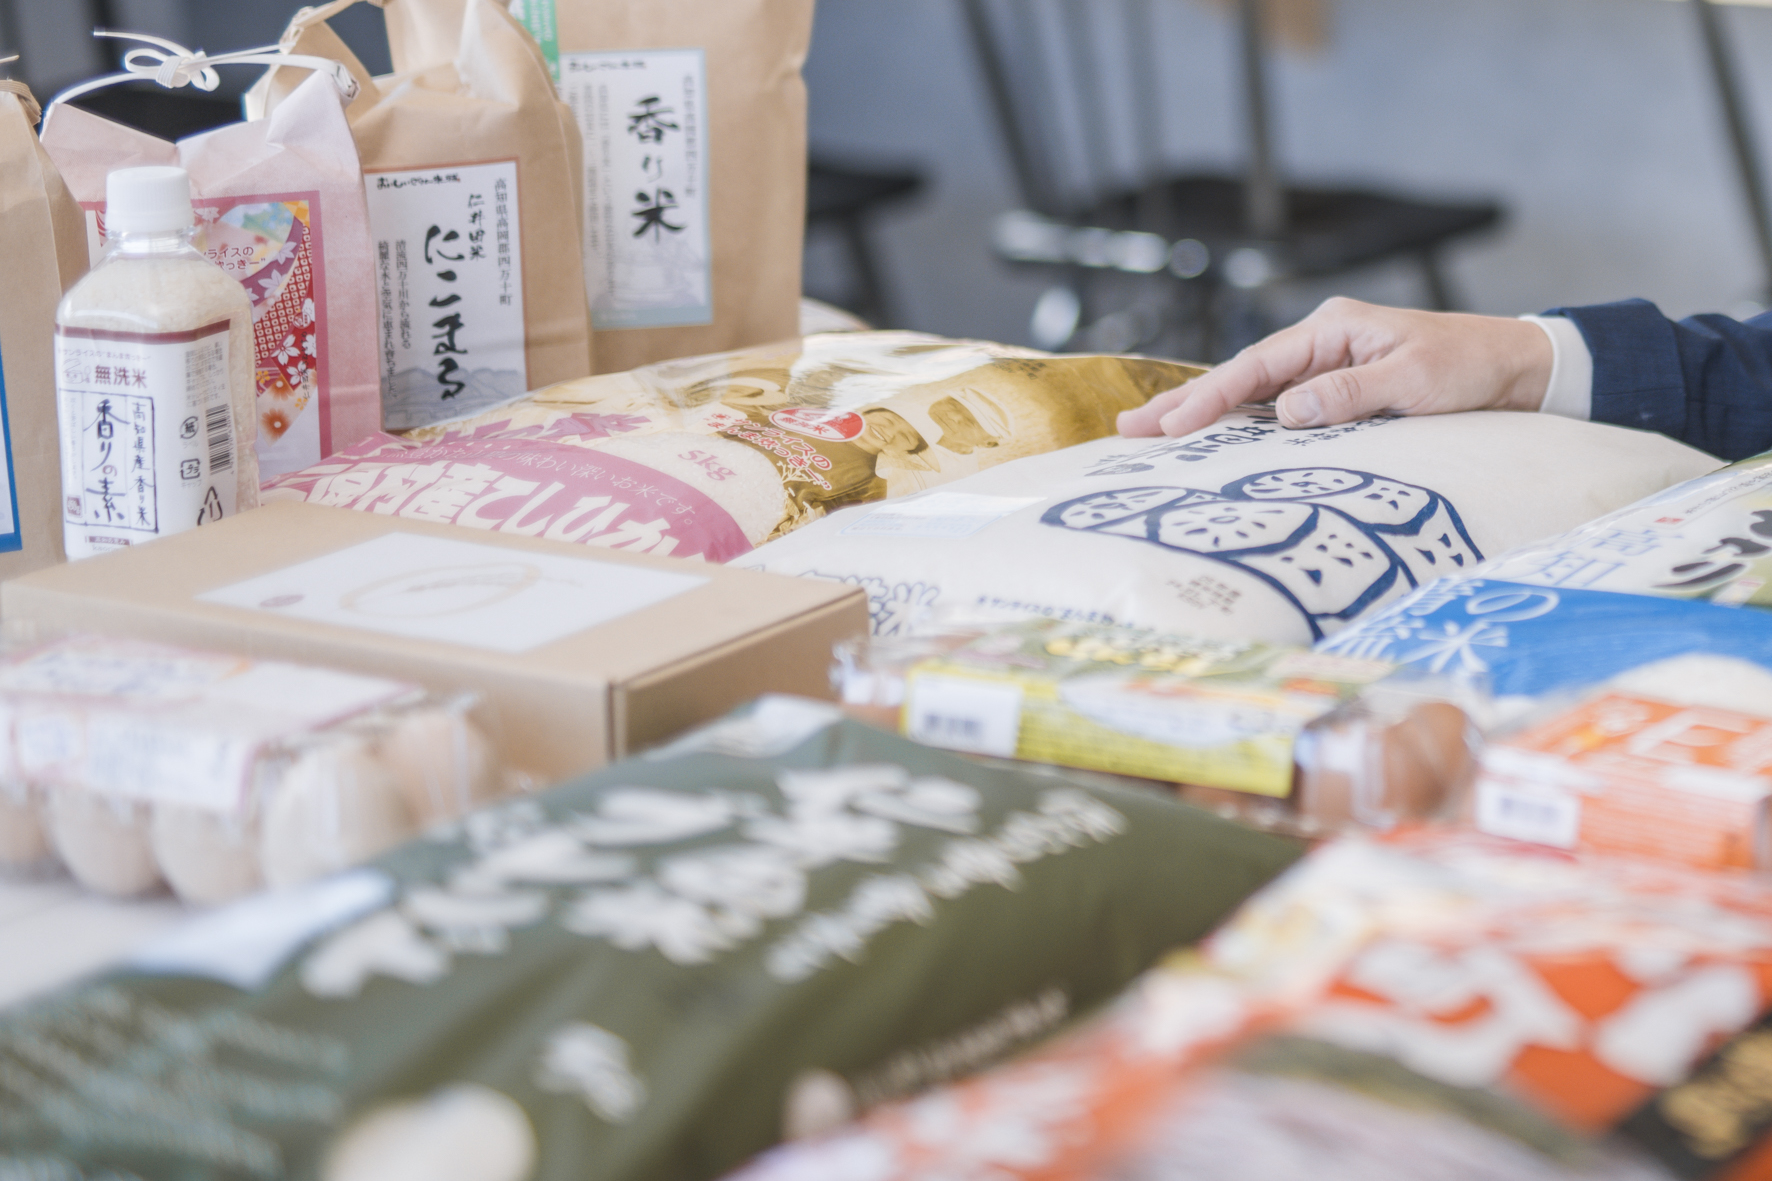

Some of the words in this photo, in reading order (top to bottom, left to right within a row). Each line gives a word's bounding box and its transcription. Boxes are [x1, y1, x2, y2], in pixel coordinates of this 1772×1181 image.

[626, 96, 688, 245] 香り米
[203, 245, 255, 263] ライスの
[468, 193, 487, 262] 仁井田米
[424, 224, 469, 401] にこまる
[94, 364, 148, 389] 無洗米
[83, 398, 131, 522] 香りの素
[678, 449, 737, 482] 5kg
